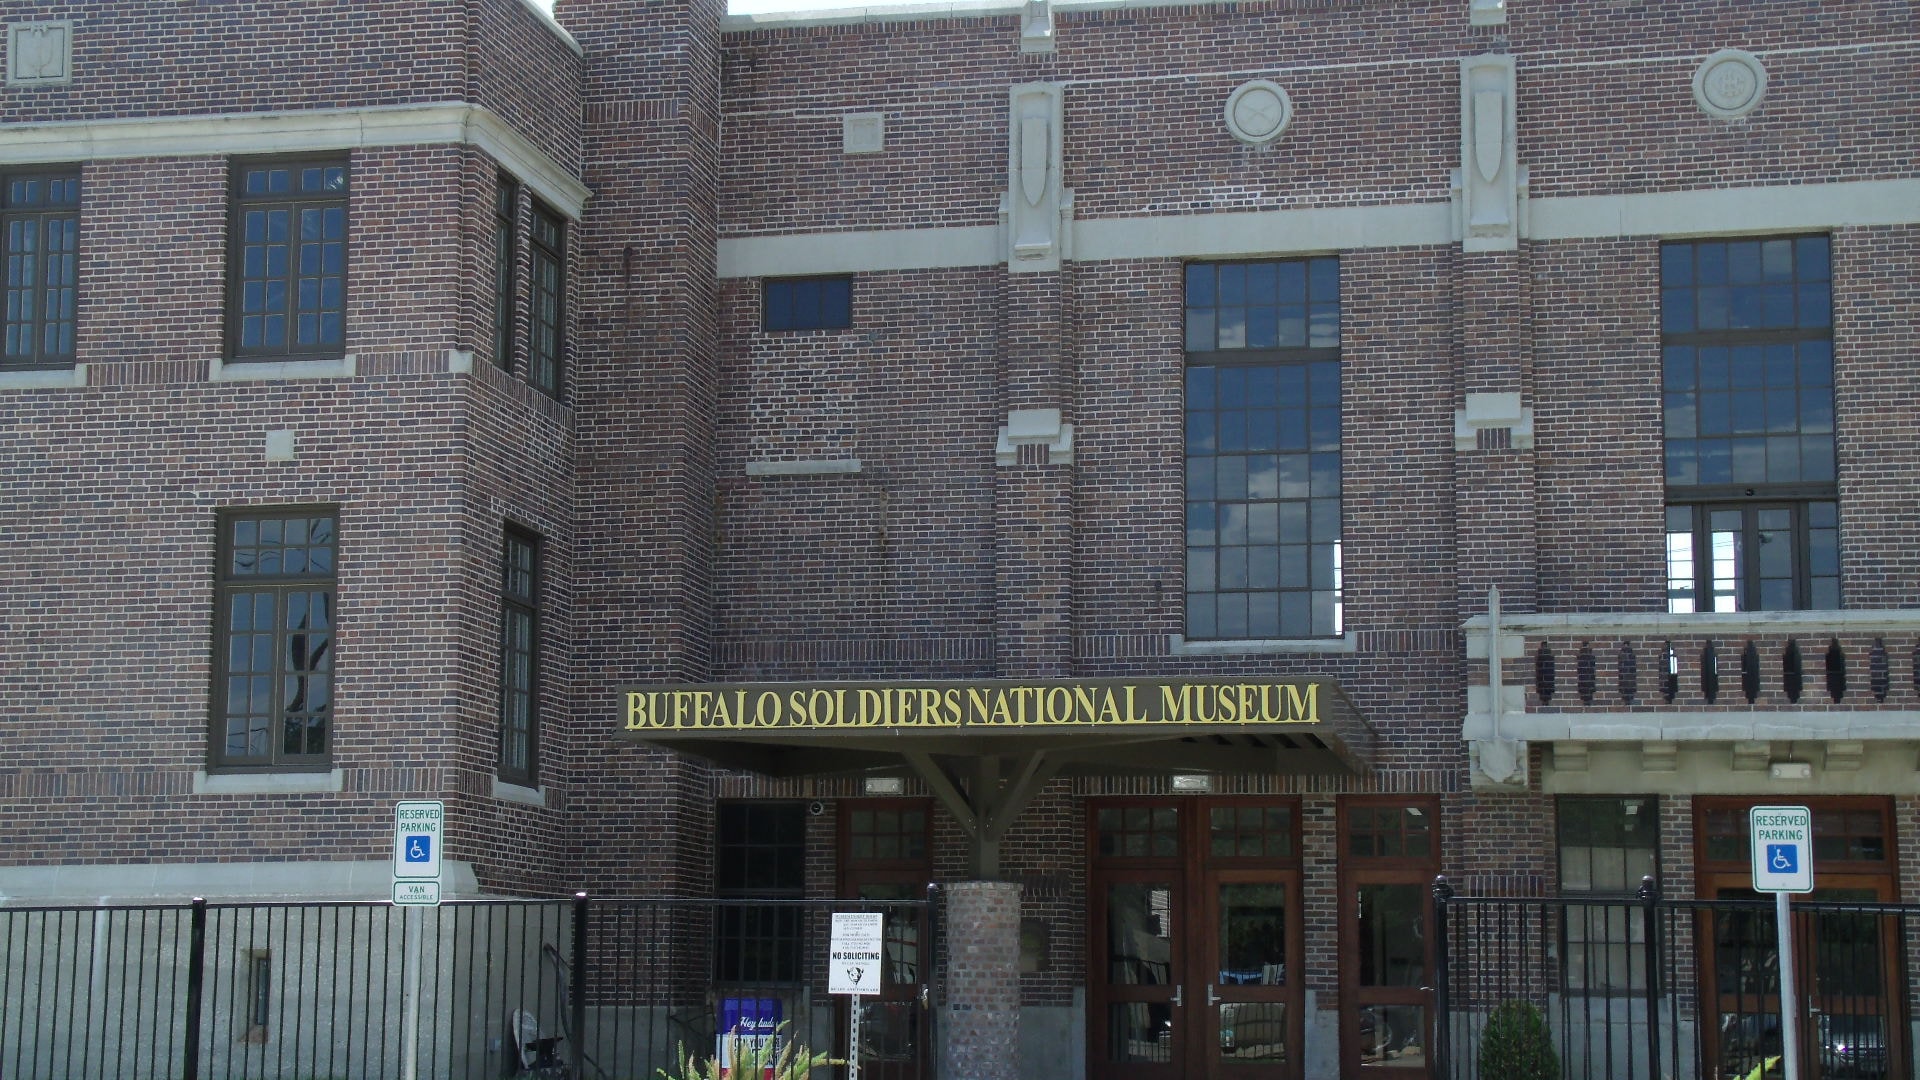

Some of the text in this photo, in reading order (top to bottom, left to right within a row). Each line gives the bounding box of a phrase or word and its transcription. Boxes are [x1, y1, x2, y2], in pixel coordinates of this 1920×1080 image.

[625, 682, 1321, 729] BUFFALO SOLDIERS NATIONAL MUSEUM
[400, 809, 440, 819] RESERVED
[1756, 815, 1807, 826] RESERVED
[400, 822, 436, 832] PARKING
[1759, 829, 1803, 840] PARKING
[408, 885, 425, 893] VAN
[832, 951, 880, 960] NO SOLICITING
[740, 1016, 756, 1031] Hey
